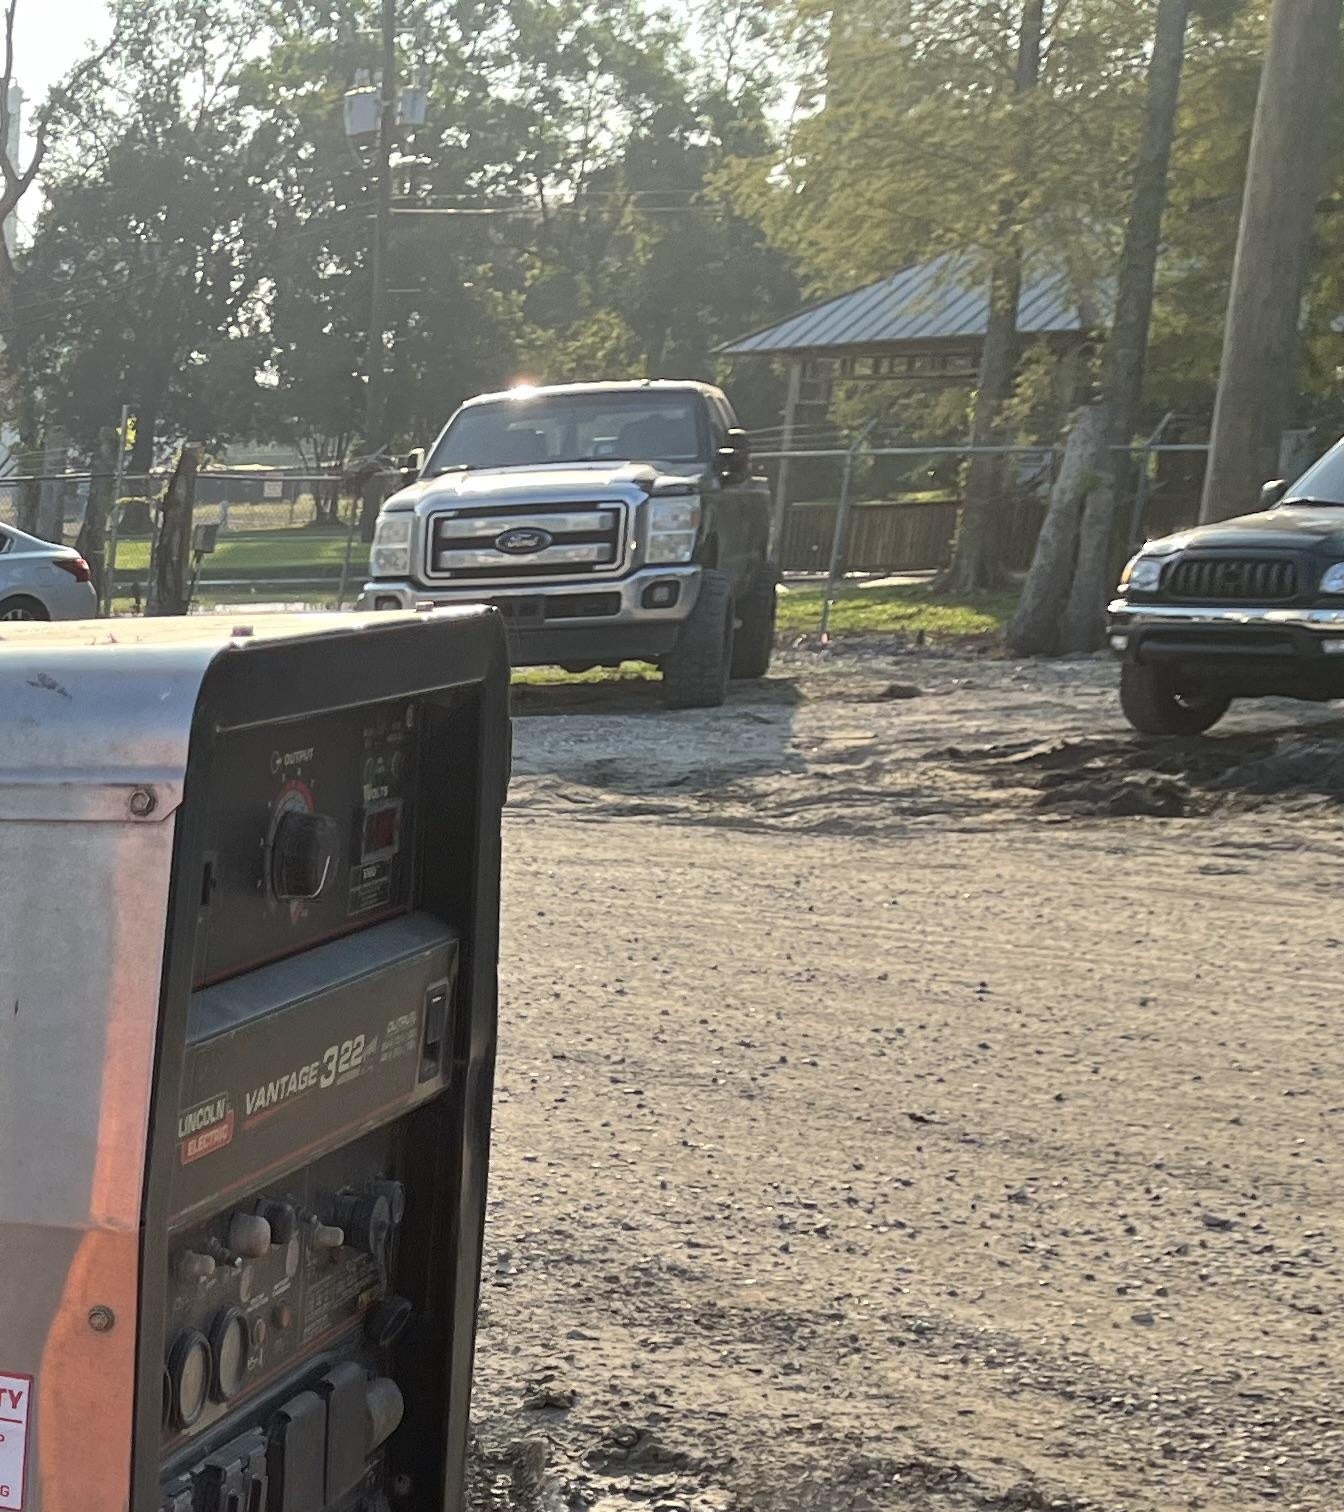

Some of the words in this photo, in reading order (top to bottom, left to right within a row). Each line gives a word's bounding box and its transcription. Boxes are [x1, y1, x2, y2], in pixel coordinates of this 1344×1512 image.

[245, 1061, 319, 1116] VANTAGE
[318, 1034, 366, 1089] 322
[178, 1098, 226, 1138] LINCOLN
[187, 1123, 229, 1157] ELECTRIC
